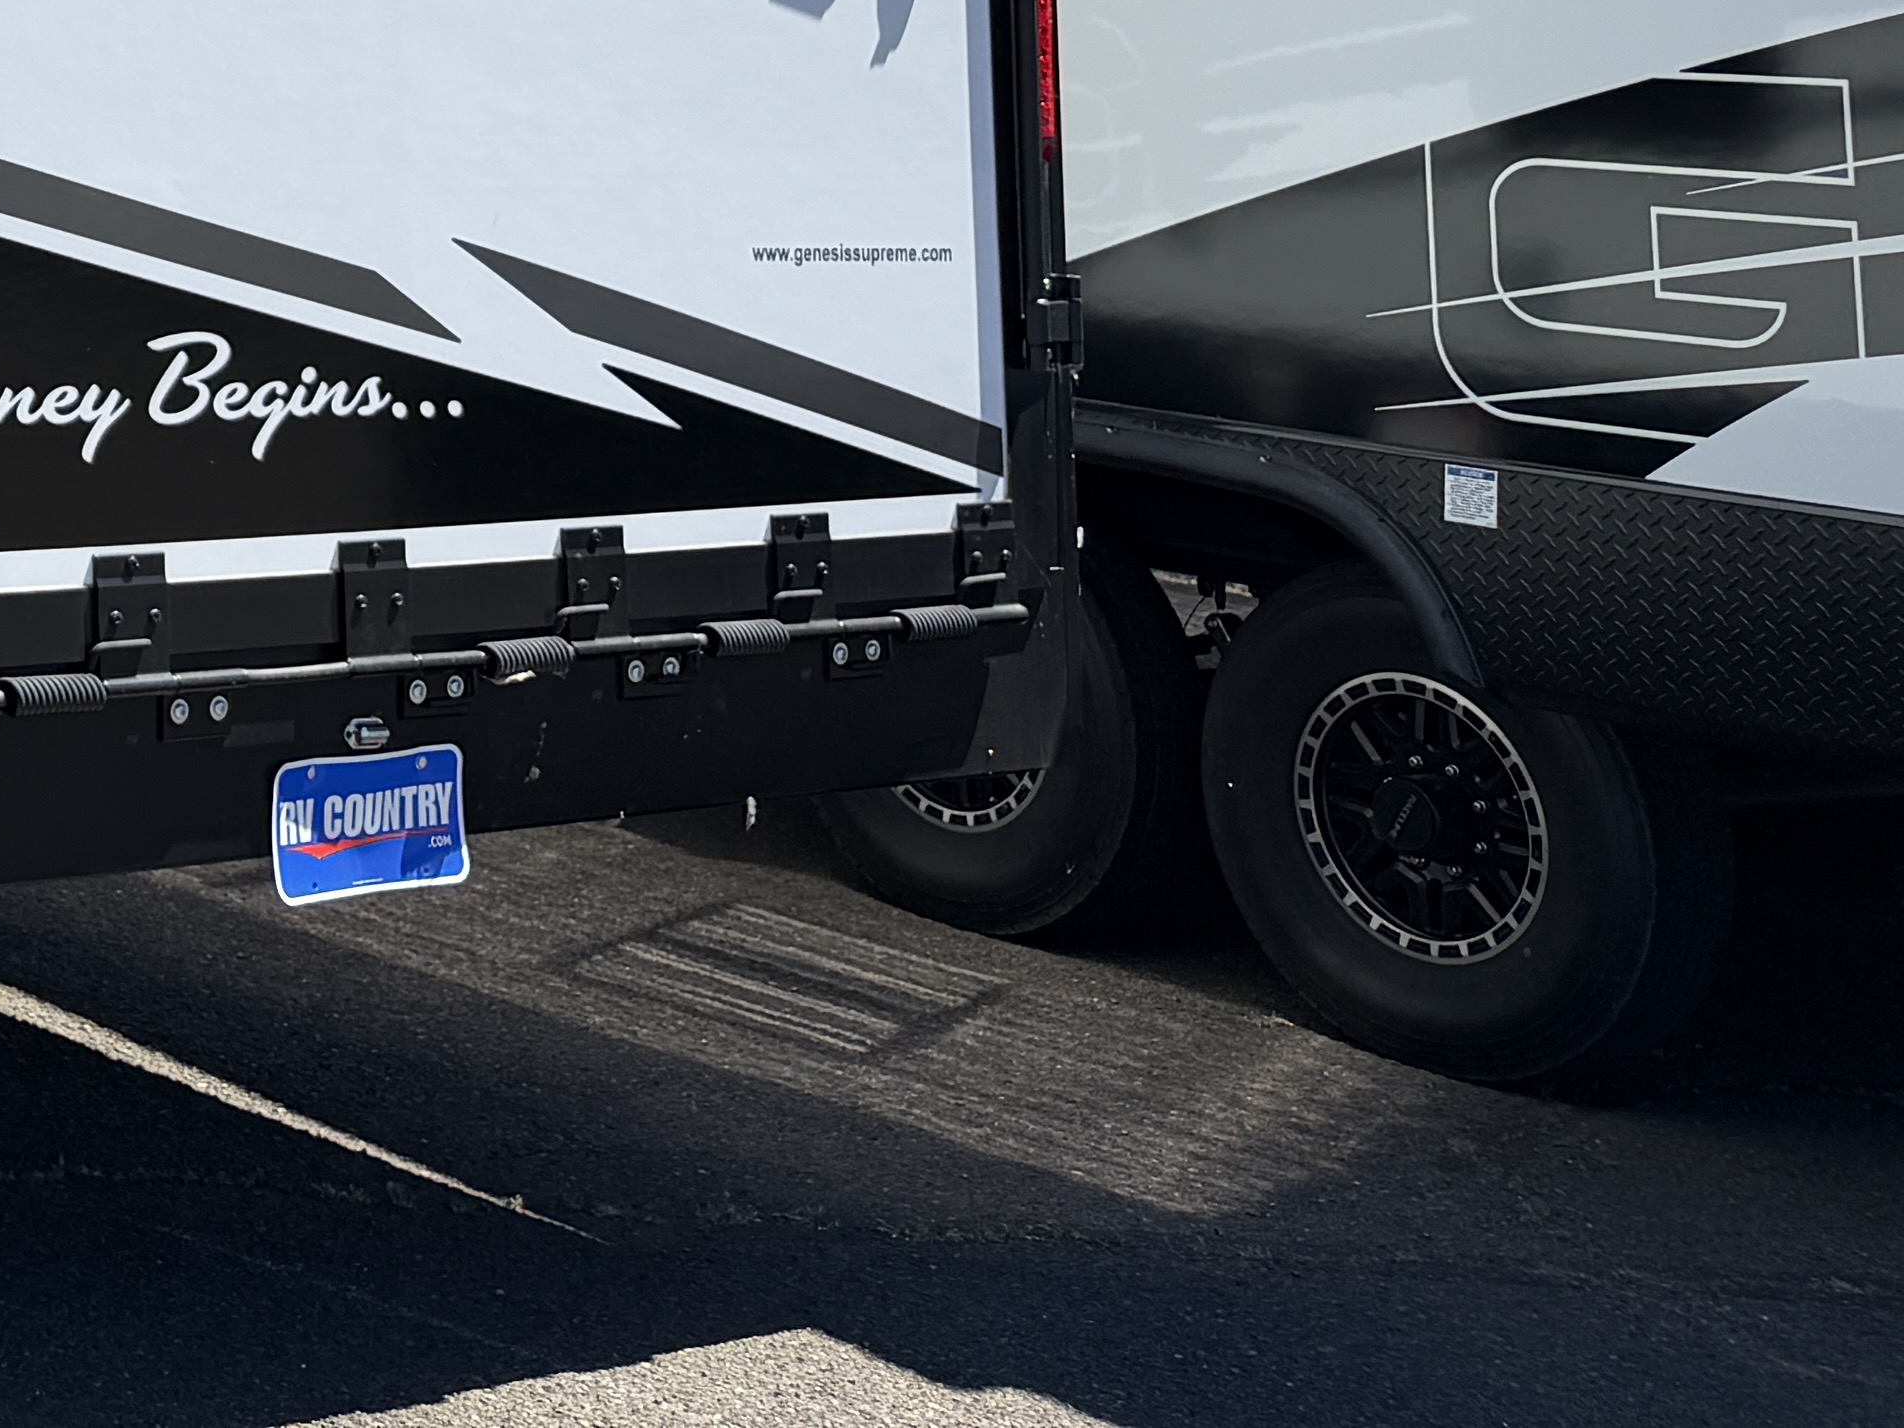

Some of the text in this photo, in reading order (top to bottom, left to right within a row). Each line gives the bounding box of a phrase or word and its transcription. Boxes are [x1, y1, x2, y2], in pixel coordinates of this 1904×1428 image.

[752, 242, 953, 266] www.genesissupreme.com
[146, 331, 466, 461] Begins...
[279, 781, 453, 846] RV COUNTRY
[427, 835, 452, 848] .COM
